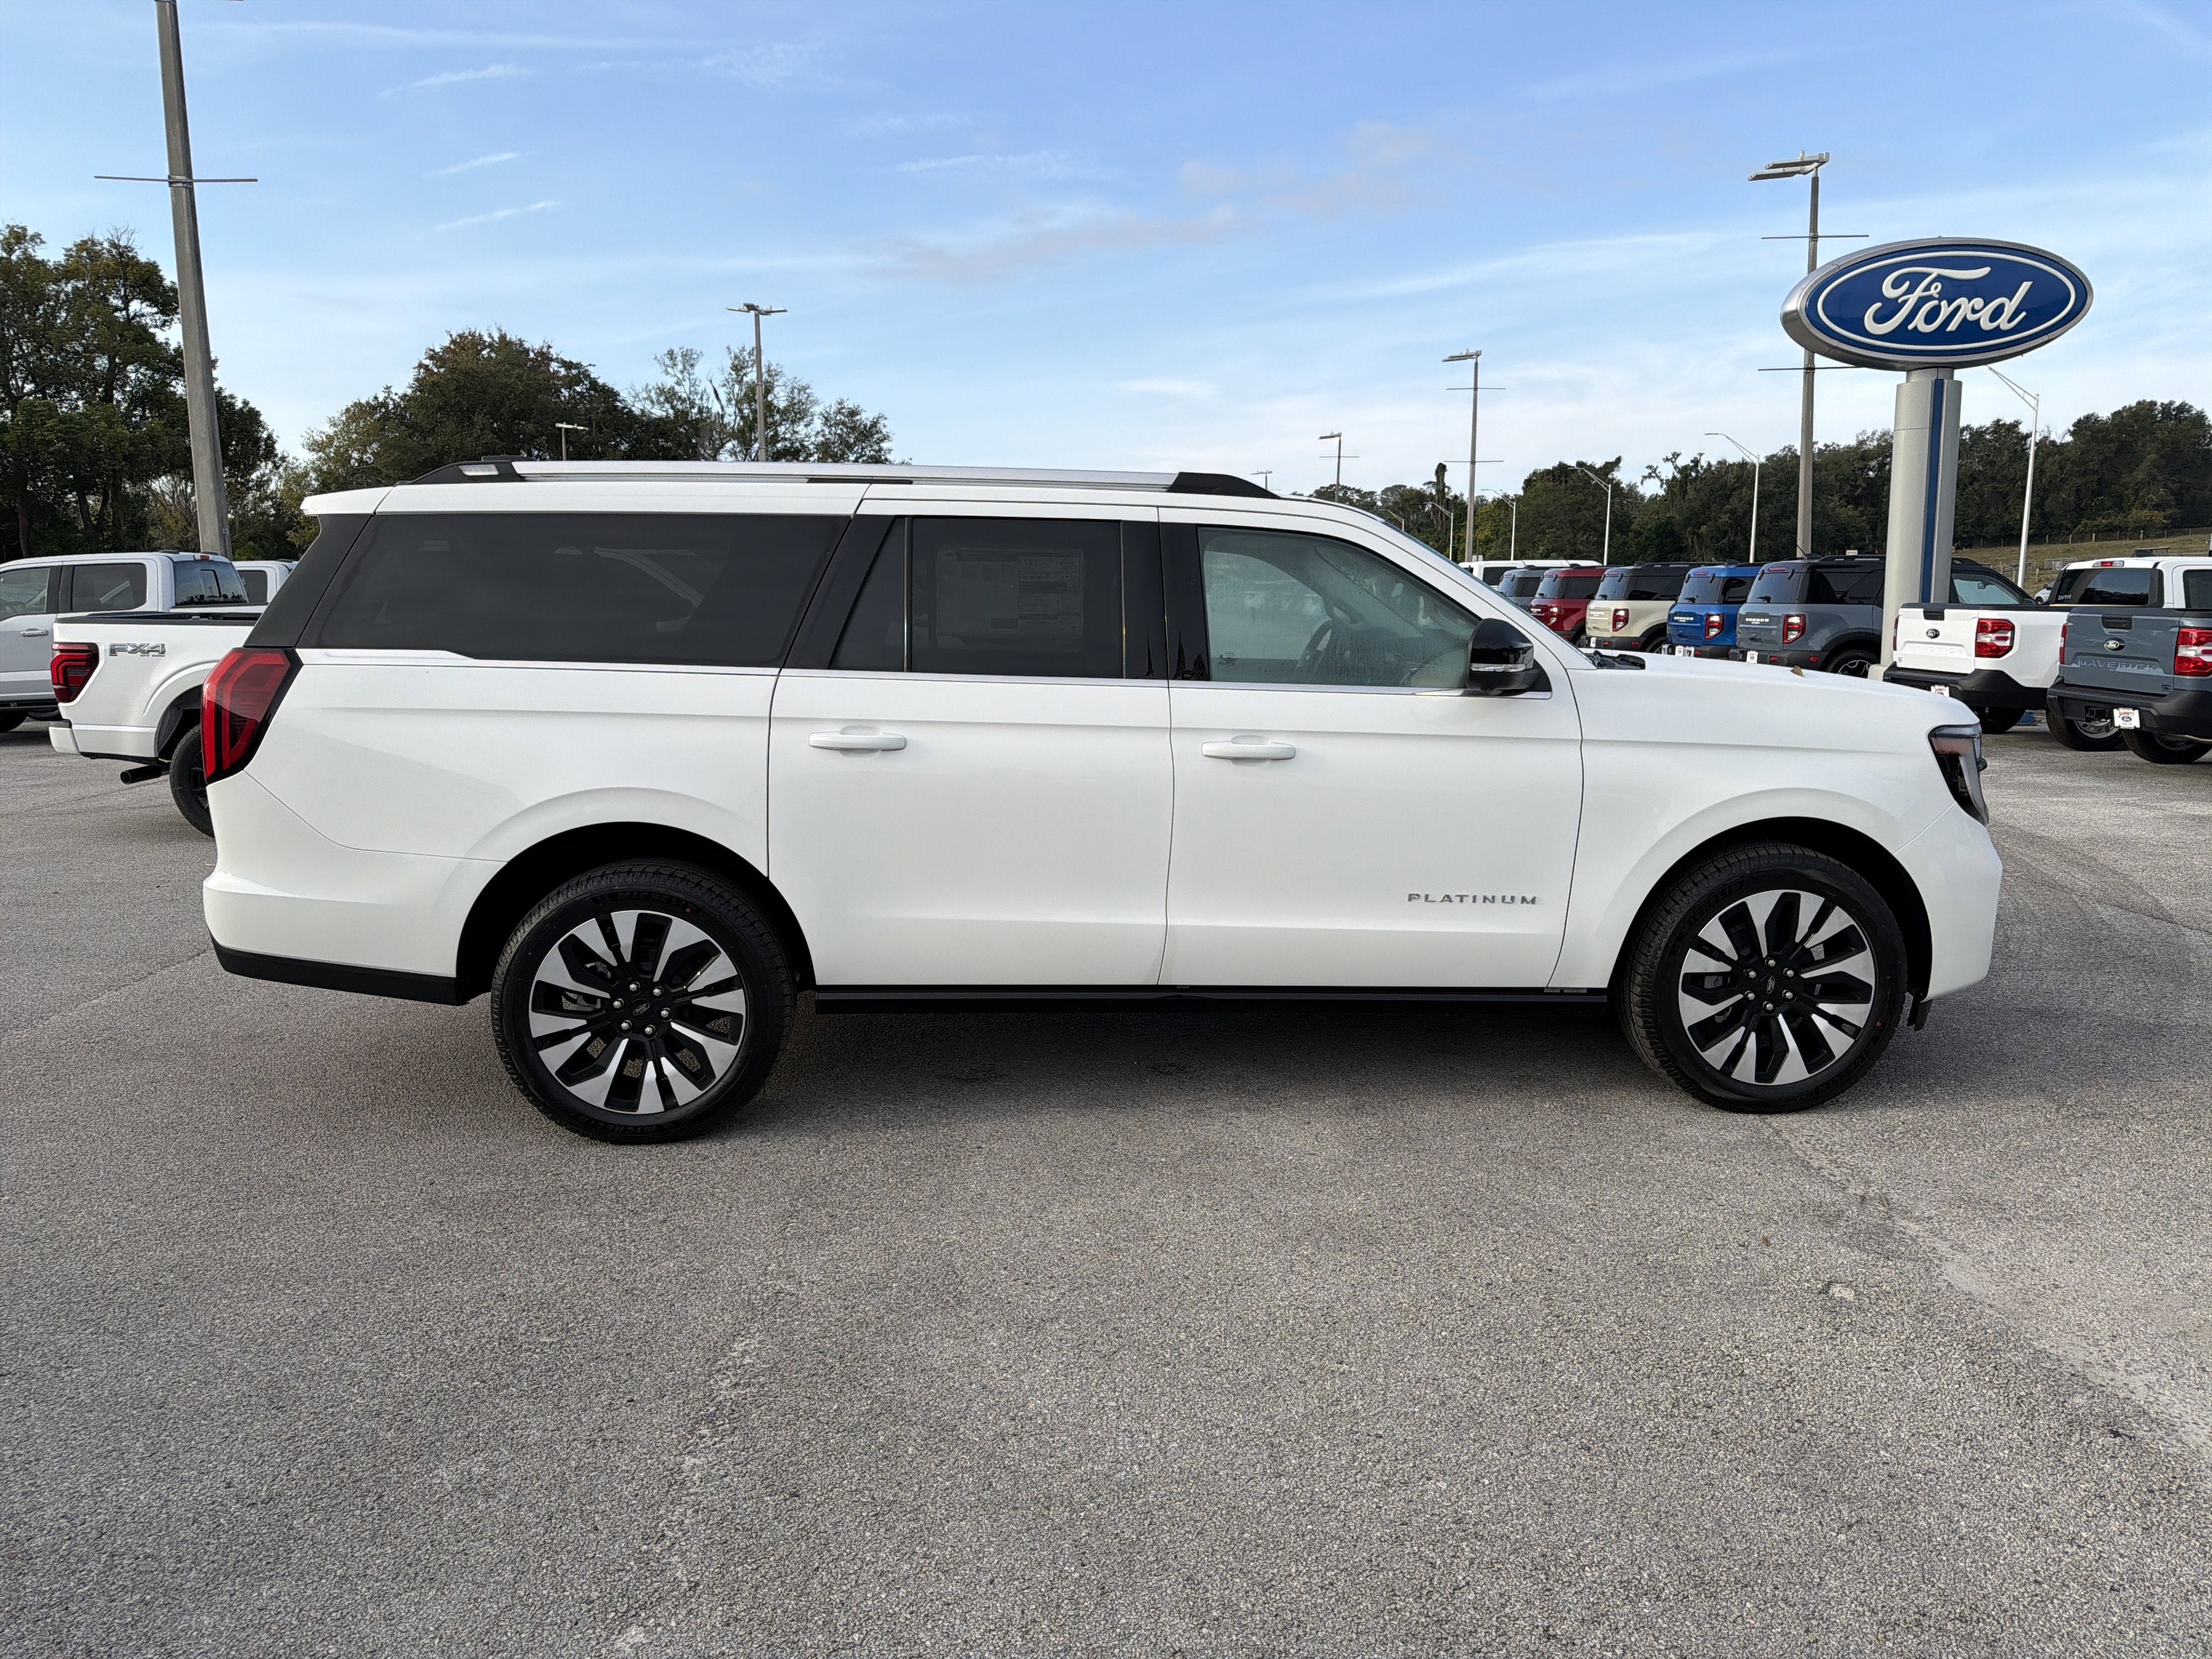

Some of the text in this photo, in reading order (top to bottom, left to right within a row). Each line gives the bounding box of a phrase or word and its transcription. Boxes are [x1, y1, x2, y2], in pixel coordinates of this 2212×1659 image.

[1864, 266, 2033, 335] Ford
[109, 643, 166, 656] FX4
[2078, 659, 2158, 672] MAVERICK
[1407, 893, 1537, 905] PLATINUM
